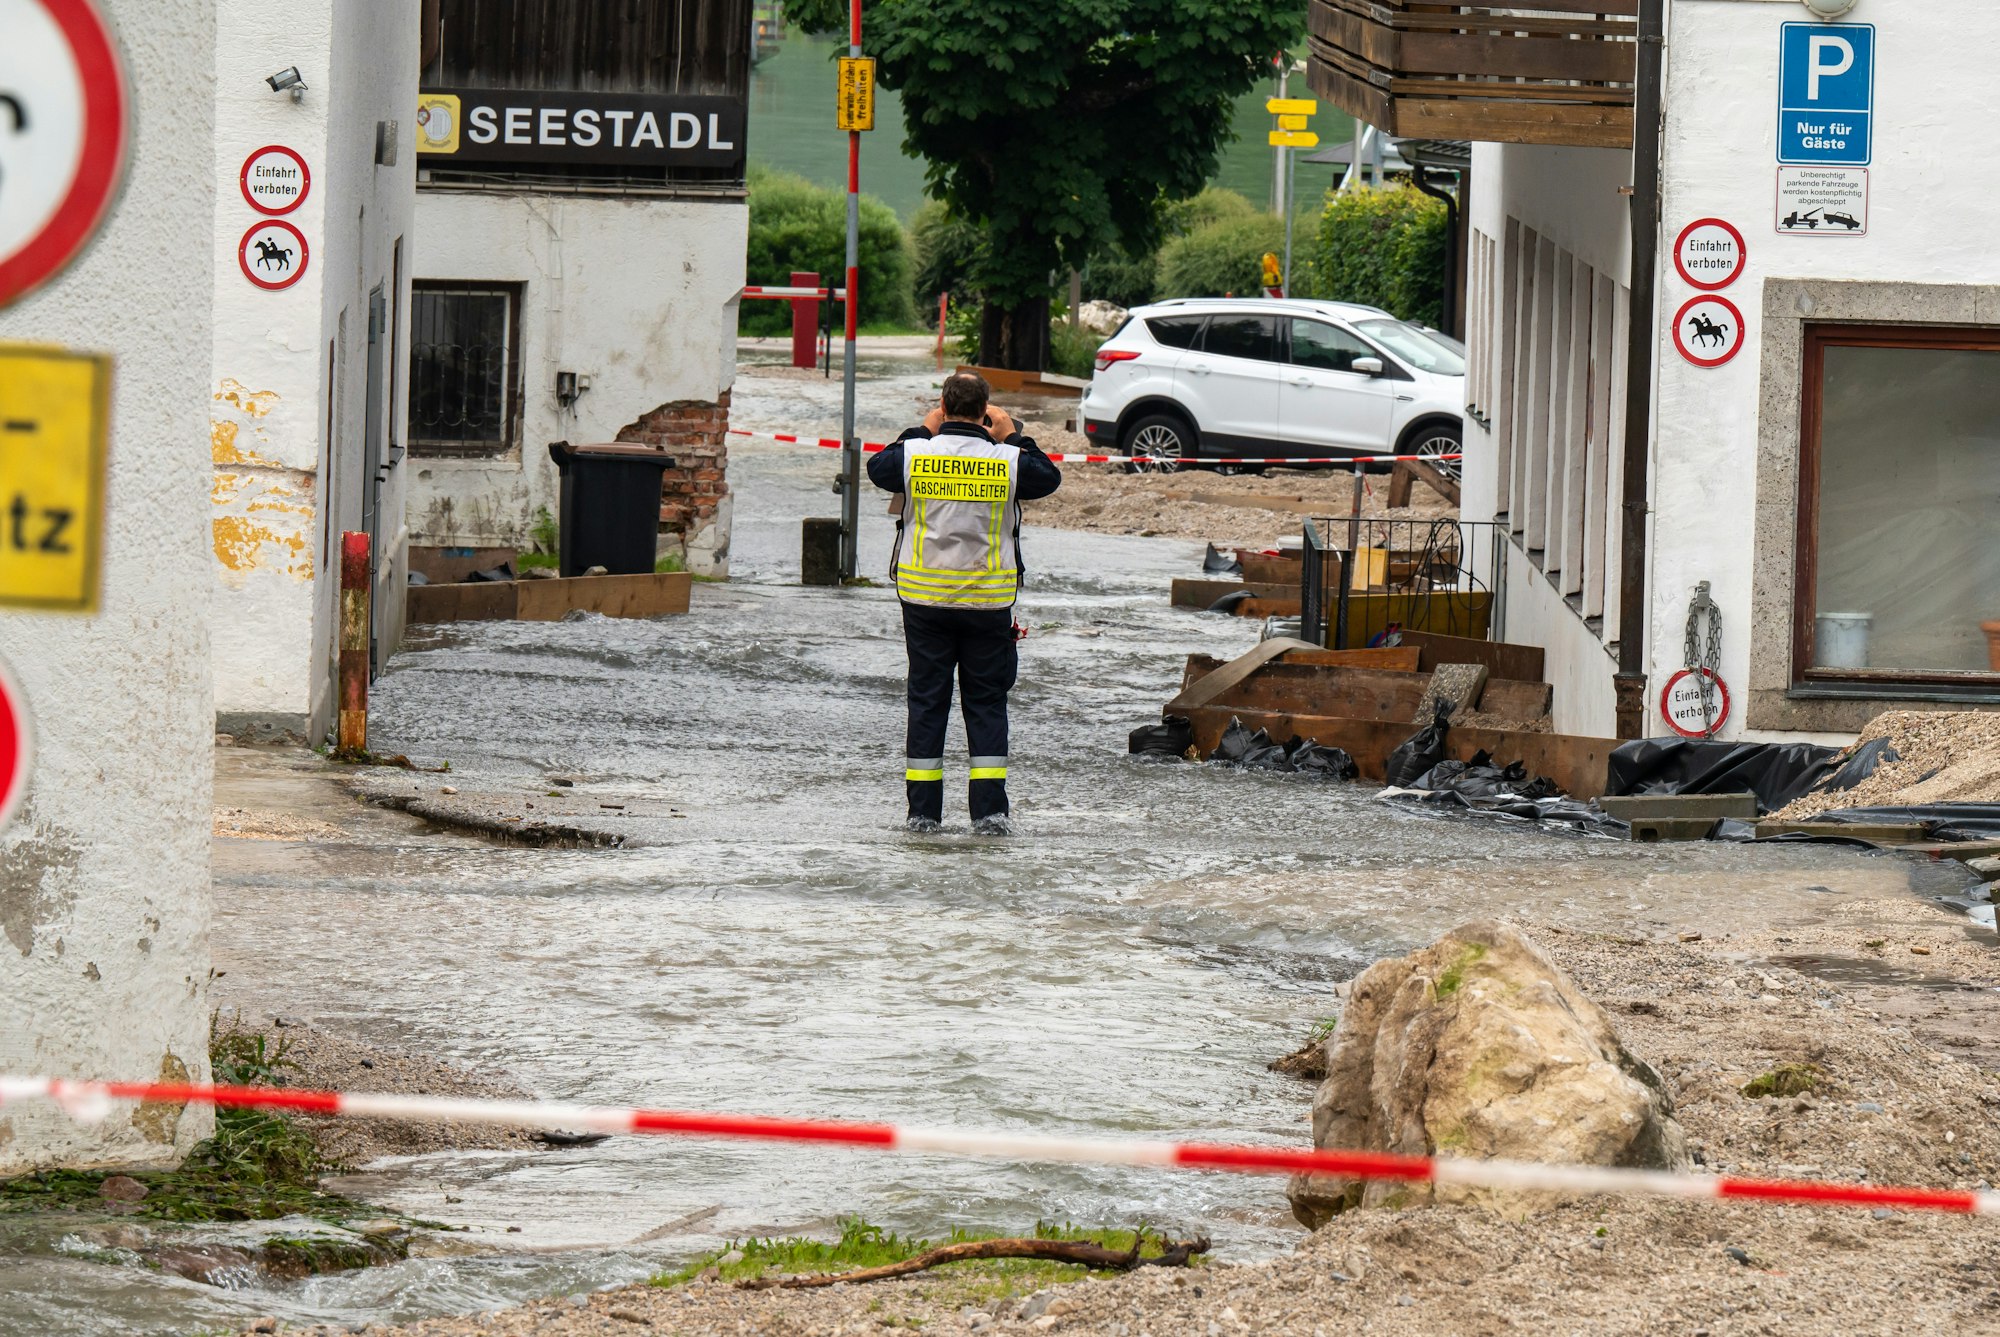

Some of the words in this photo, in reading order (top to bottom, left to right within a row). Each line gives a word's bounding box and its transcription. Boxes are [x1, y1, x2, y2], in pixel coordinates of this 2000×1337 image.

[1807, 35, 1855, 101] P
[857, 69, 868, 119] freihalten
[468, 106, 734, 150] SEESTADL
[1797, 121, 1825, 135] Nur
[1829, 123, 1852, 135] für
[1802, 136, 1846, 150] Gäste
[256, 165, 297, 179] Einfahrt
[1800, 171, 1846, 181] Unberechtigt
[253, 182, 297, 195] verboten
[1786, 180, 1820, 188] parkende
[1821, 181, 1859, 190] Fahrzeuge
[1810, 189, 1863, 199] kostenpflichtig
[1798, 198, 1847, 206] abgeschleppt
[1690, 239, 1731, 252] Einfahrt
[1687, 257, 1733, 269] verboten
[913, 458, 1007, 478] FEUERWEHR
[914, 481, 1007, 499] ABSCHNITTSLEITER
